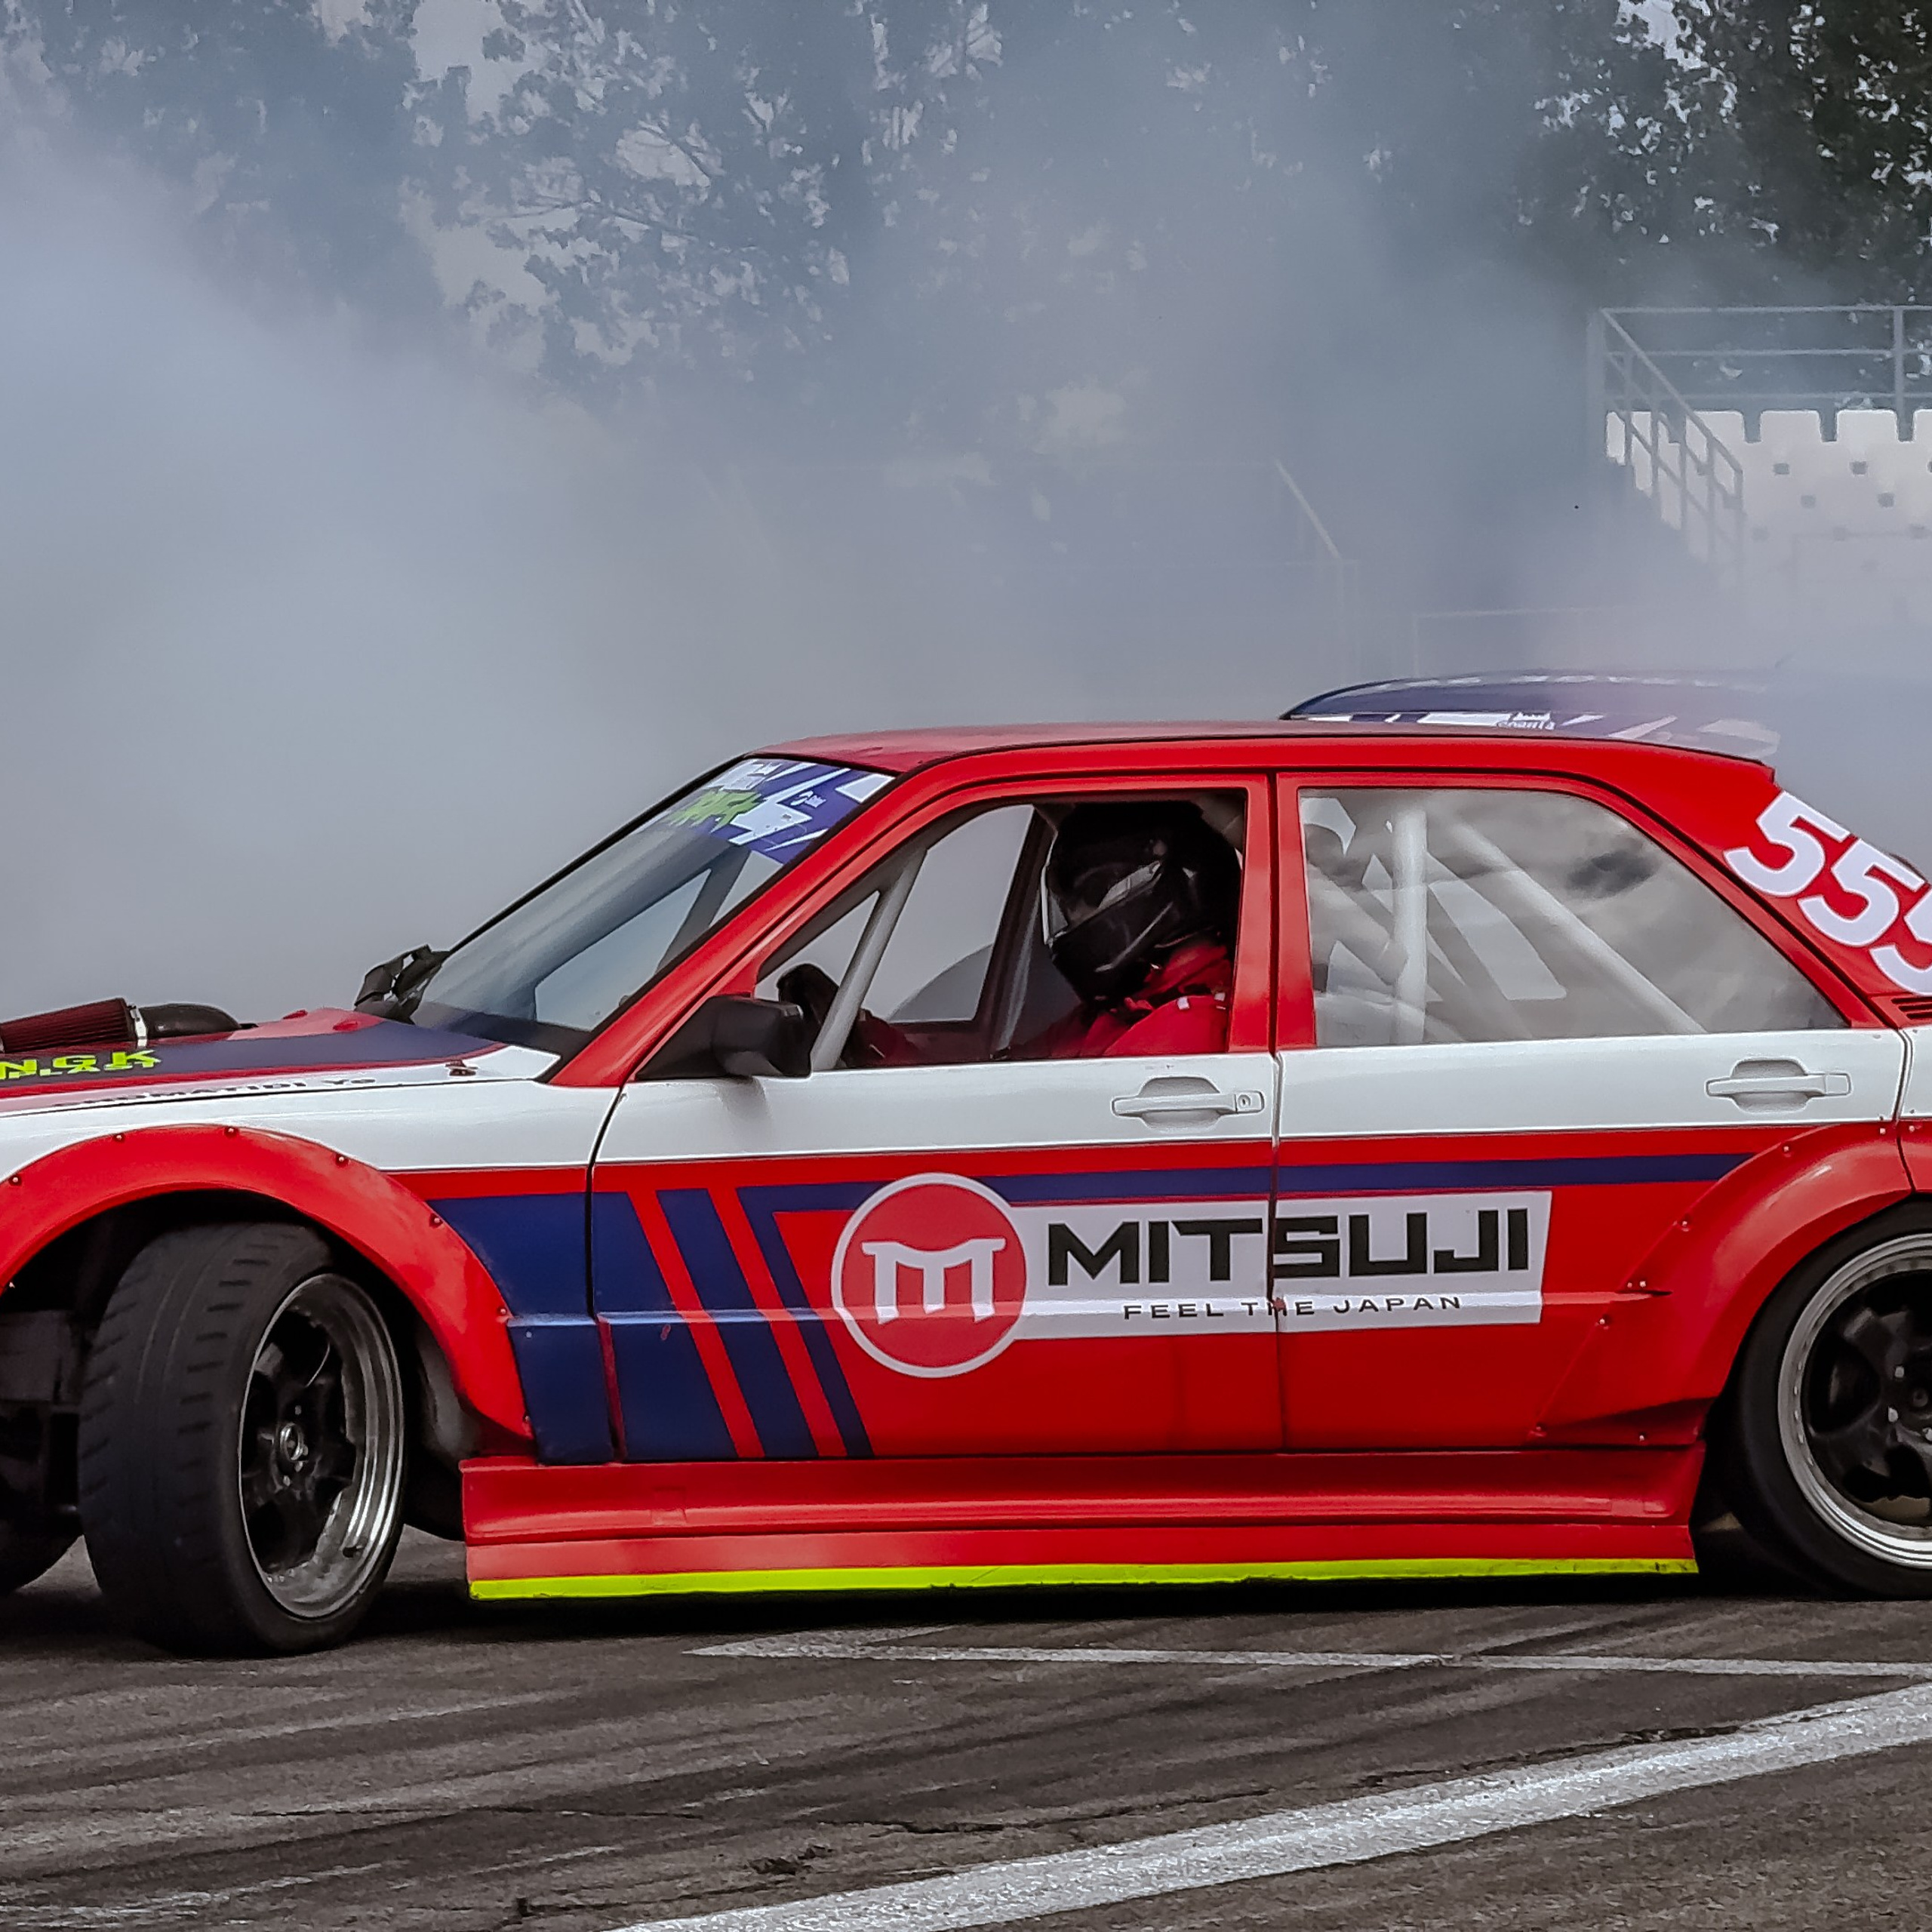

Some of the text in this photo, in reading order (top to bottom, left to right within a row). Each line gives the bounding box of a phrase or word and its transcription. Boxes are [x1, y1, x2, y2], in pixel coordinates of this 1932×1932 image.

[1048, 1208, 1529, 1287] MITSUJI
[1123, 1296, 1461, 1320] FEEL THE JAPAN
